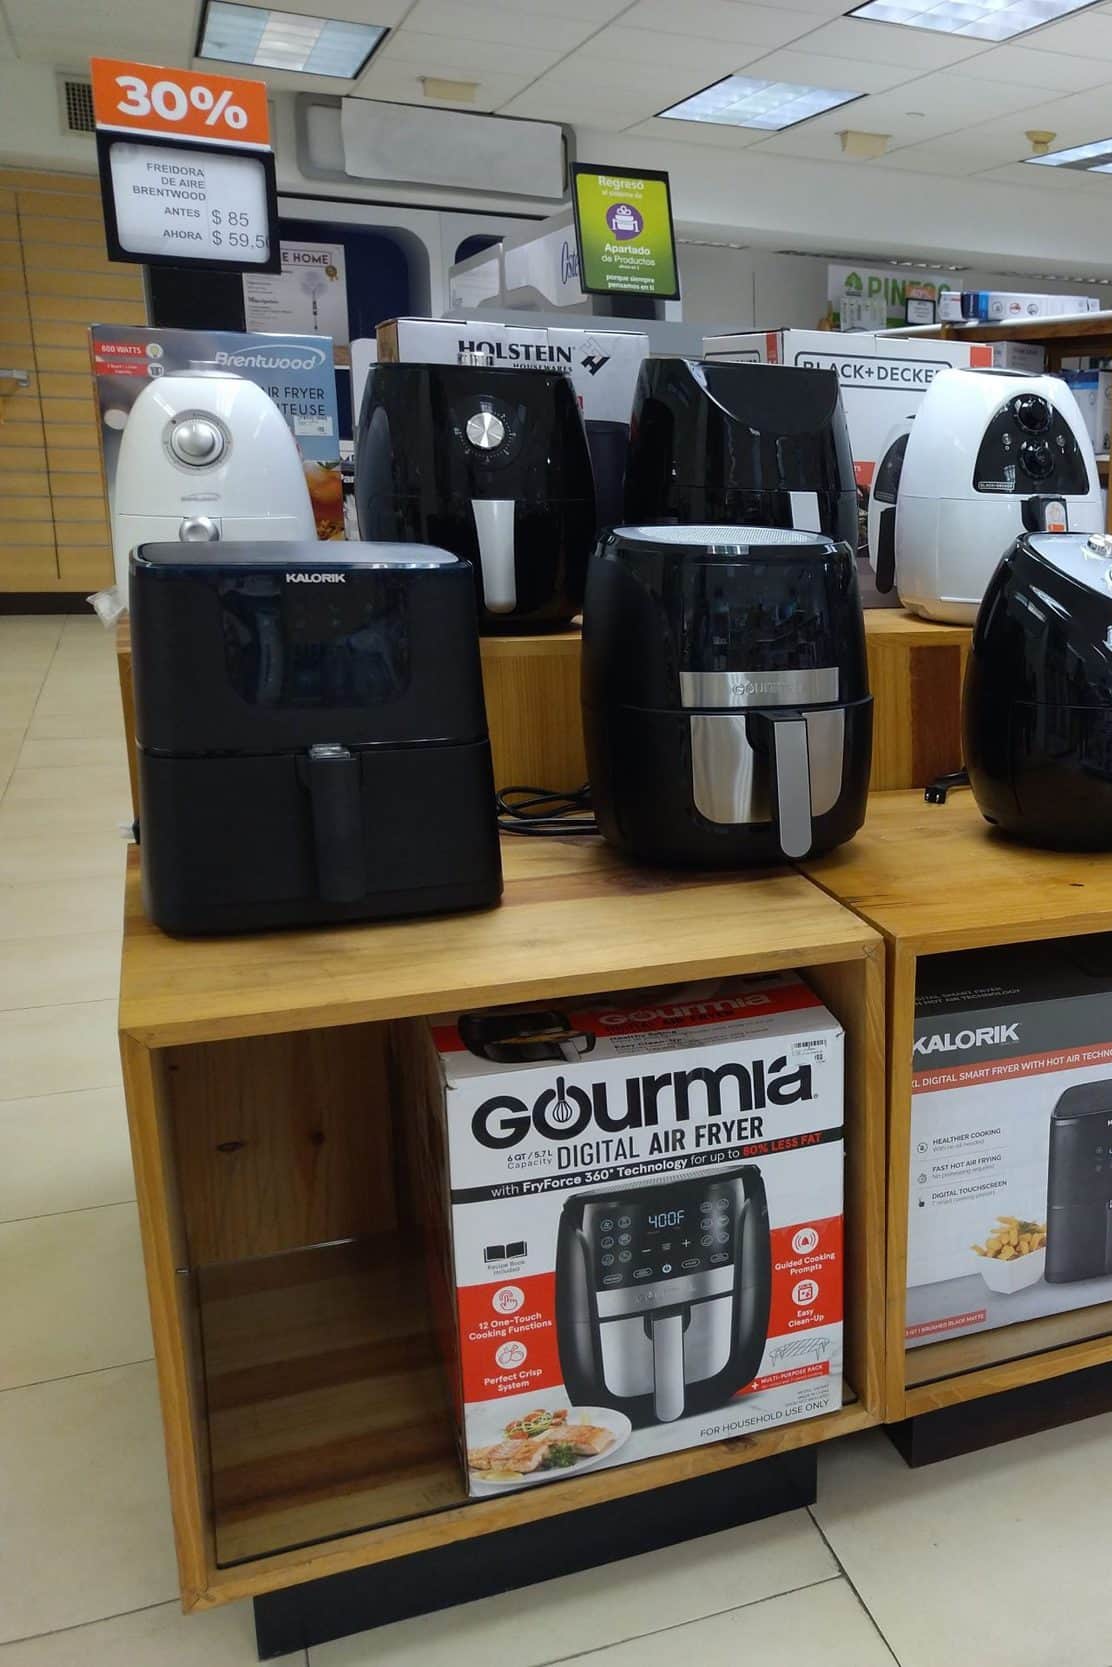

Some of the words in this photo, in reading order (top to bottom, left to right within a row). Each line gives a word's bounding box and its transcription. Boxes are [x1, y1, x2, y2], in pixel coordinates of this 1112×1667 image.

[115, 76, 248, 130] 30%
[146, 163, 205, 178] FREIDORA
[161, 177, 177, 187] DE
[179, 178, 205, 190] AIRE
[132, 185, 206, 201] BRENTWOOD
[164, 207, 201, 218] ANTES
[211, 209, 222, 226] $
[228, 211, 249, 227] 85
[163, 229, 203, 241] AHORA
[212, 230, 223, 246] $
[604, 243, 651, 256] Apartado
[293, 252, 329, 265] HOME
[614, 256, 656, 267] Productos
[458, 340, 571, 363] HOLSTEIN
[215, 351, 317, 370] Brentwood
[284, 388, 324, 400] FRYER
[285, 573, 346, 583] KALORIK
[600, 994, 770, 1025] Gourmia
[913, 1023, 1020, 1055] KALORIK
[923, 1075, 957, 1087] DIGITAL
[959, 1068, 991, 1081] SMART
[992, 1065, 1019, 1076] FRYER
[1021, 1059, 1045, 1071] WITH
[1046, 1056, 1064, 1066] HOT
[1066, 1054, 1080, 1063] AIR
[471, 1056, 813, 1149] Gourmia
[557, 1136, 640, 1170] DIGITAL
[649, 1128, 686, 1156] AIR
[695, 1116, 764, 1148] FRYER
[933, 1134, 969, 1145] HEALTHIER
[971, 1128, 1001, 1139] COOKING
[507, 1158, 552, 1170] Capacity
[514, 1153, 527, 1161] QT
[534, 1151, 547, 1159] 5.7
[932, 1164, 949, 1172] FAST
[950, 1161, 964, 1169] HOT
[978, 1155, 1001, 1164] FRYING
[491, 1183, 520, 1198] with
[522, 1174, 582, 1193] FryForce
[617, 1158, 688, 1178] Technology
[690, 1154, 706, 1167] for
[710, 1151, 725, 1163] up
[728, 1149, 740, 1159] to
[771, 1138, 798, 1151] LESS
[801, 1132, 823, 1146] FAT
[932, 1189, 957, 1199] DIGITAL
[960, 1181, 1007, 1195] TOUCHSCREEN
[648, 1209, 685, 1229] 400F
[775, 1258, 803, 1271] Guided
[804, 1252, 836, 1264] Cooking
[790, 1264, 823, 1276] Prompts
[479, 1321, 489, 1330] 12
[491, 1312, 542, 1328] One-Touch
[788, 1313, 825, 1328] Clean-Up
[797, 1309, 814, 1318] Easy
[468, 1328, 507, 1340] Cooking
[508, 1320, 552, 1334] Functions
[484, 1373, 517, 1386] Perfect
[519, 1368, 543, 1378] Crisp
[497, 1380, 530, 1393] System
[700, 1426, 721, 1437] FOR
[722, 1410, 783, 1433] HOUSEHOLD
[785, 1406, 801, 1417] USE
[805, 1399, 830, 1412] ONLY
